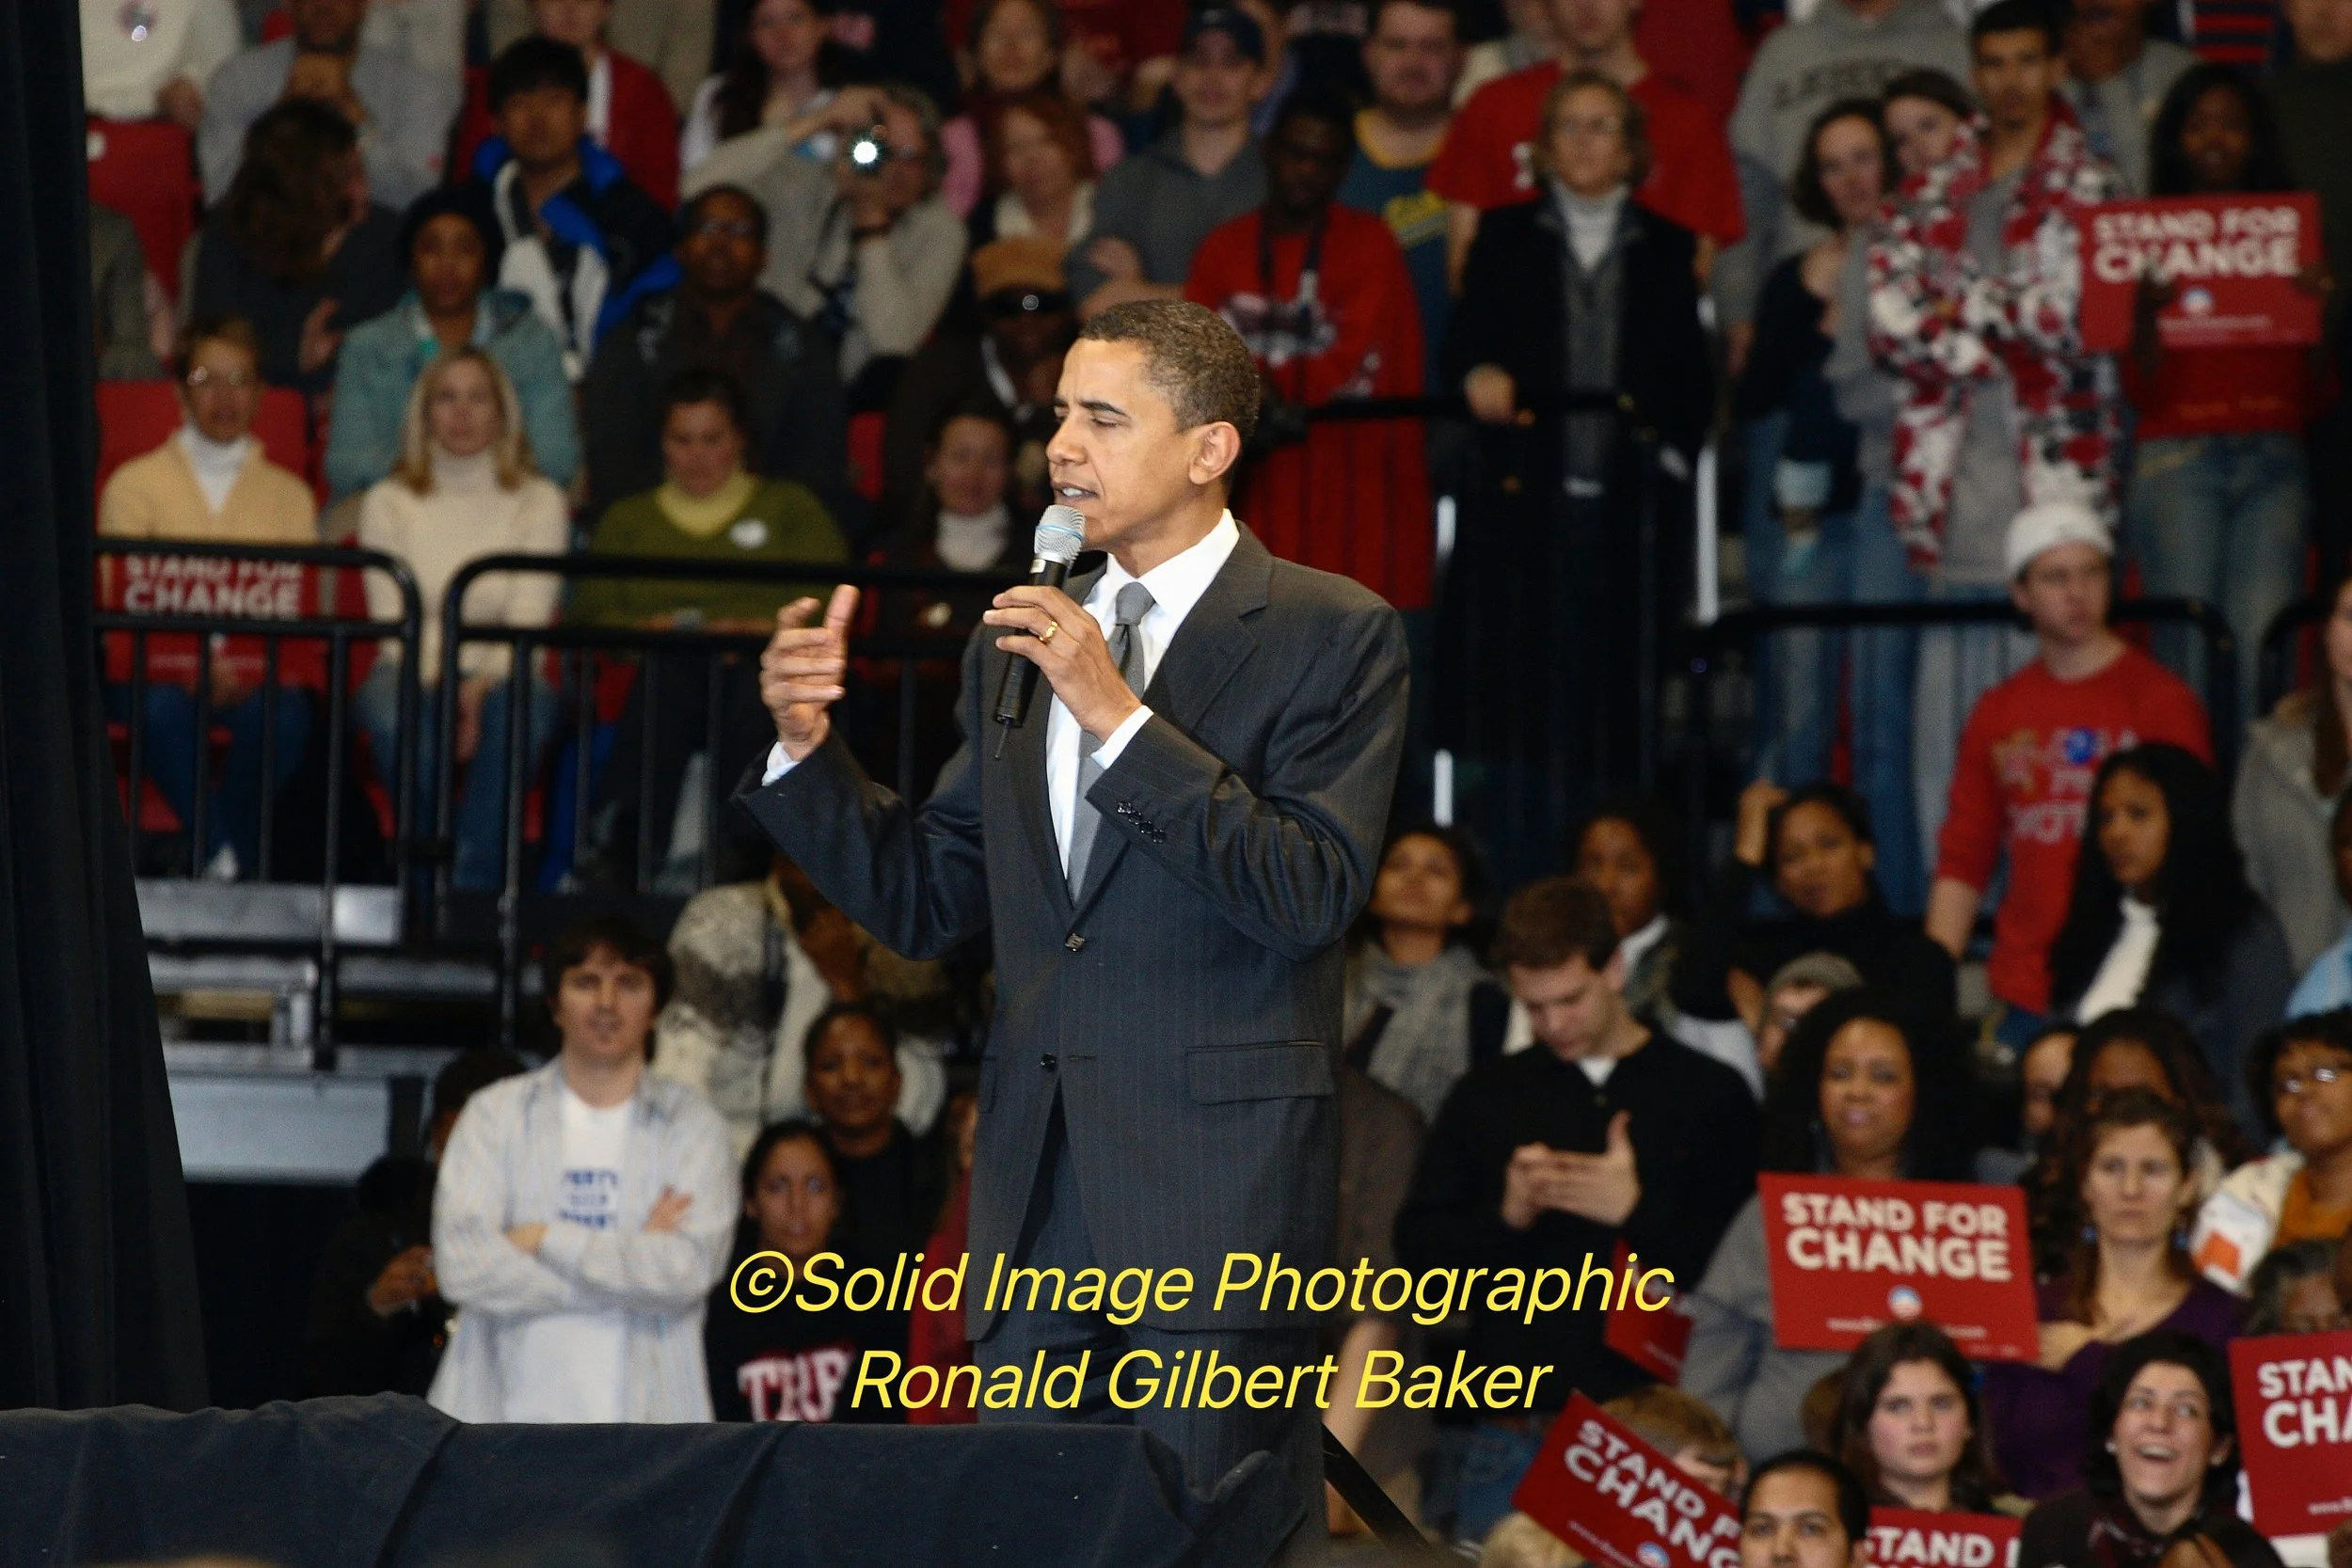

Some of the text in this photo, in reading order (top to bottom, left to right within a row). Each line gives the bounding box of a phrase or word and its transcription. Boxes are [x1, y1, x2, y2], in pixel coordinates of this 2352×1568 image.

[2092, 205, 2300, 241] STAND FOR
[2093, 236, 2299, 283] CHANGE
[125, 578, 300, 621] CHANGE
[1782, 1192, 2009, 1237] STAND FOR
[1787, 1226, 2013, 1282] CHANGE
[1575, 1418, 1708, 1520] STAND
[1865, 1525, 1996, 1568] TAND
